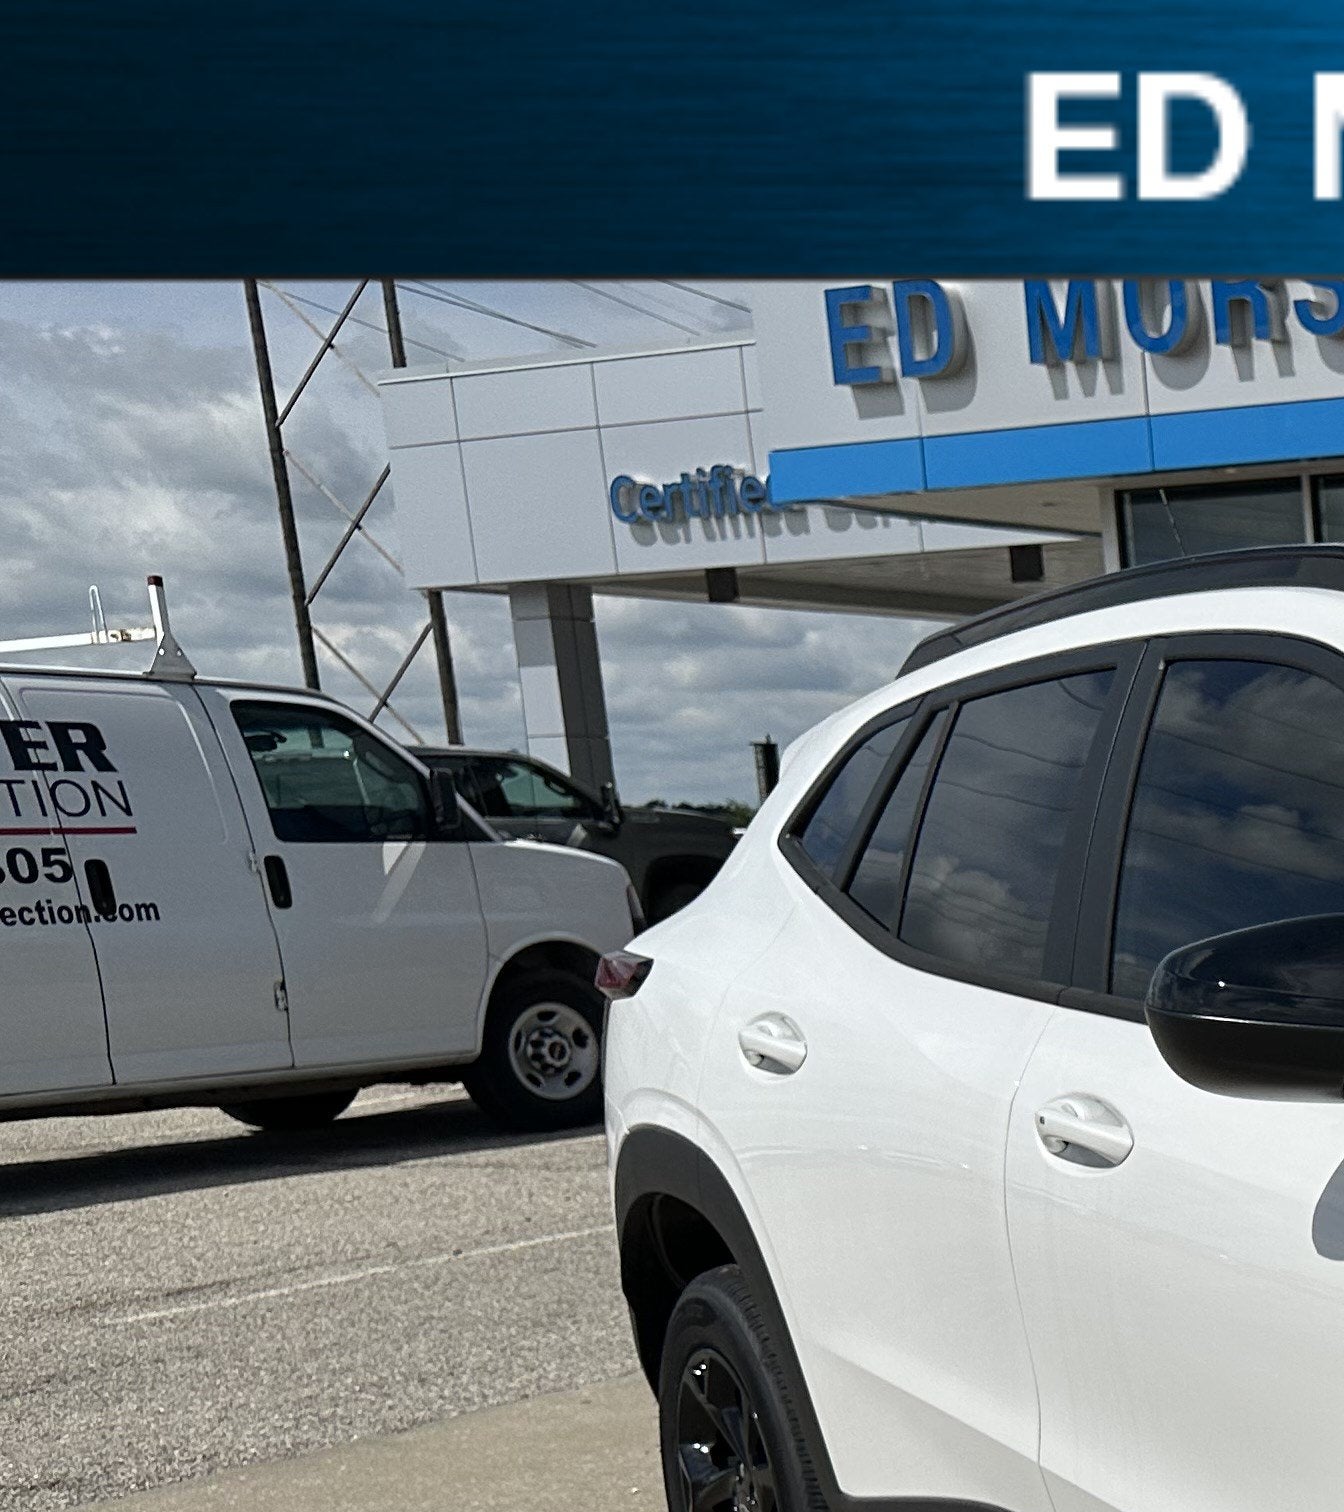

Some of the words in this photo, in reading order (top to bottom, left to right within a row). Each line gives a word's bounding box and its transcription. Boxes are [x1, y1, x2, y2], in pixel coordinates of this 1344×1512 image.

[825, 279, 960, 387] ED
[0, 720, 118, 773] ER
[0, 779, 133, 818] TION
[0, 847, 74, 884] 05
